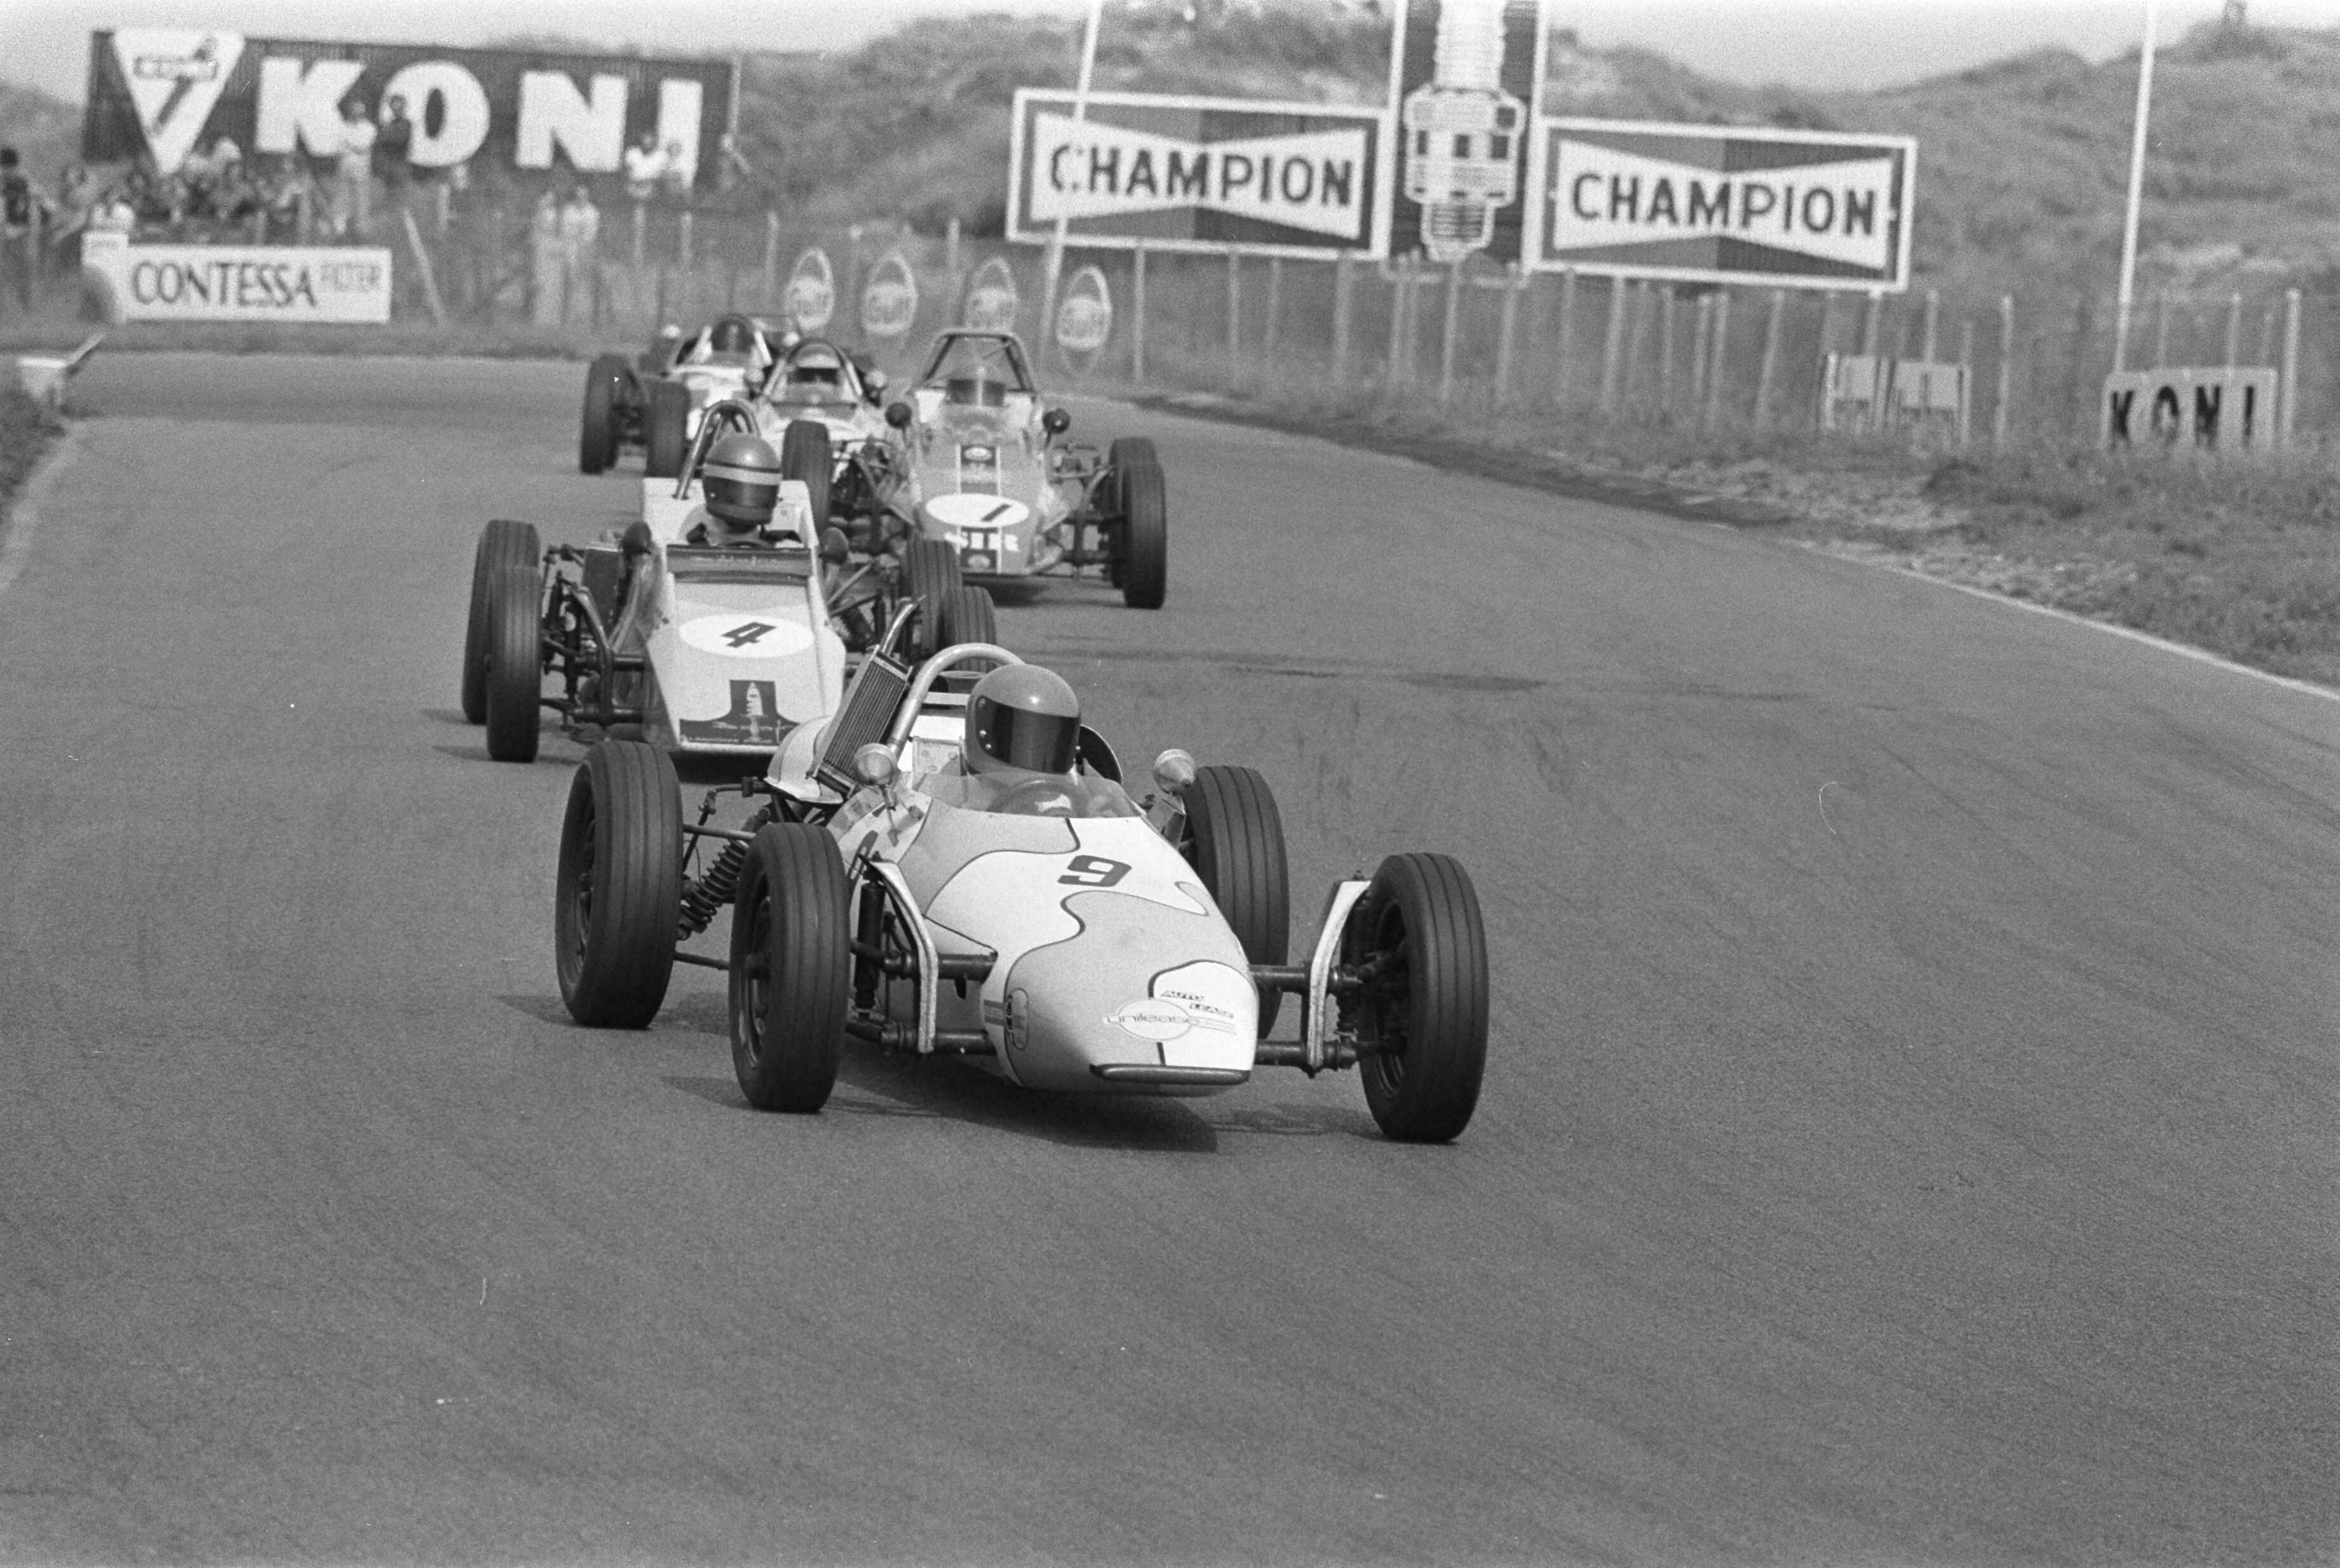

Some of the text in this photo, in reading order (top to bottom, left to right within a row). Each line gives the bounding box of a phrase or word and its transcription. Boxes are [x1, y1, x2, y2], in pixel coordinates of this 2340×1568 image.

[257, 57, 703, 175] KONI
[1050, 142, 1353, 208] CHAMPION
[1572, 172, 1876, 237] CHAMPION
[132, 260, 316, 308] CONTESSA
[2110, 384, 2256, 448] KONI
[980, 503, 1012, 523] 1
[720, 621, 777, 649] 4
[1057, 853, 1133, 888] 9
